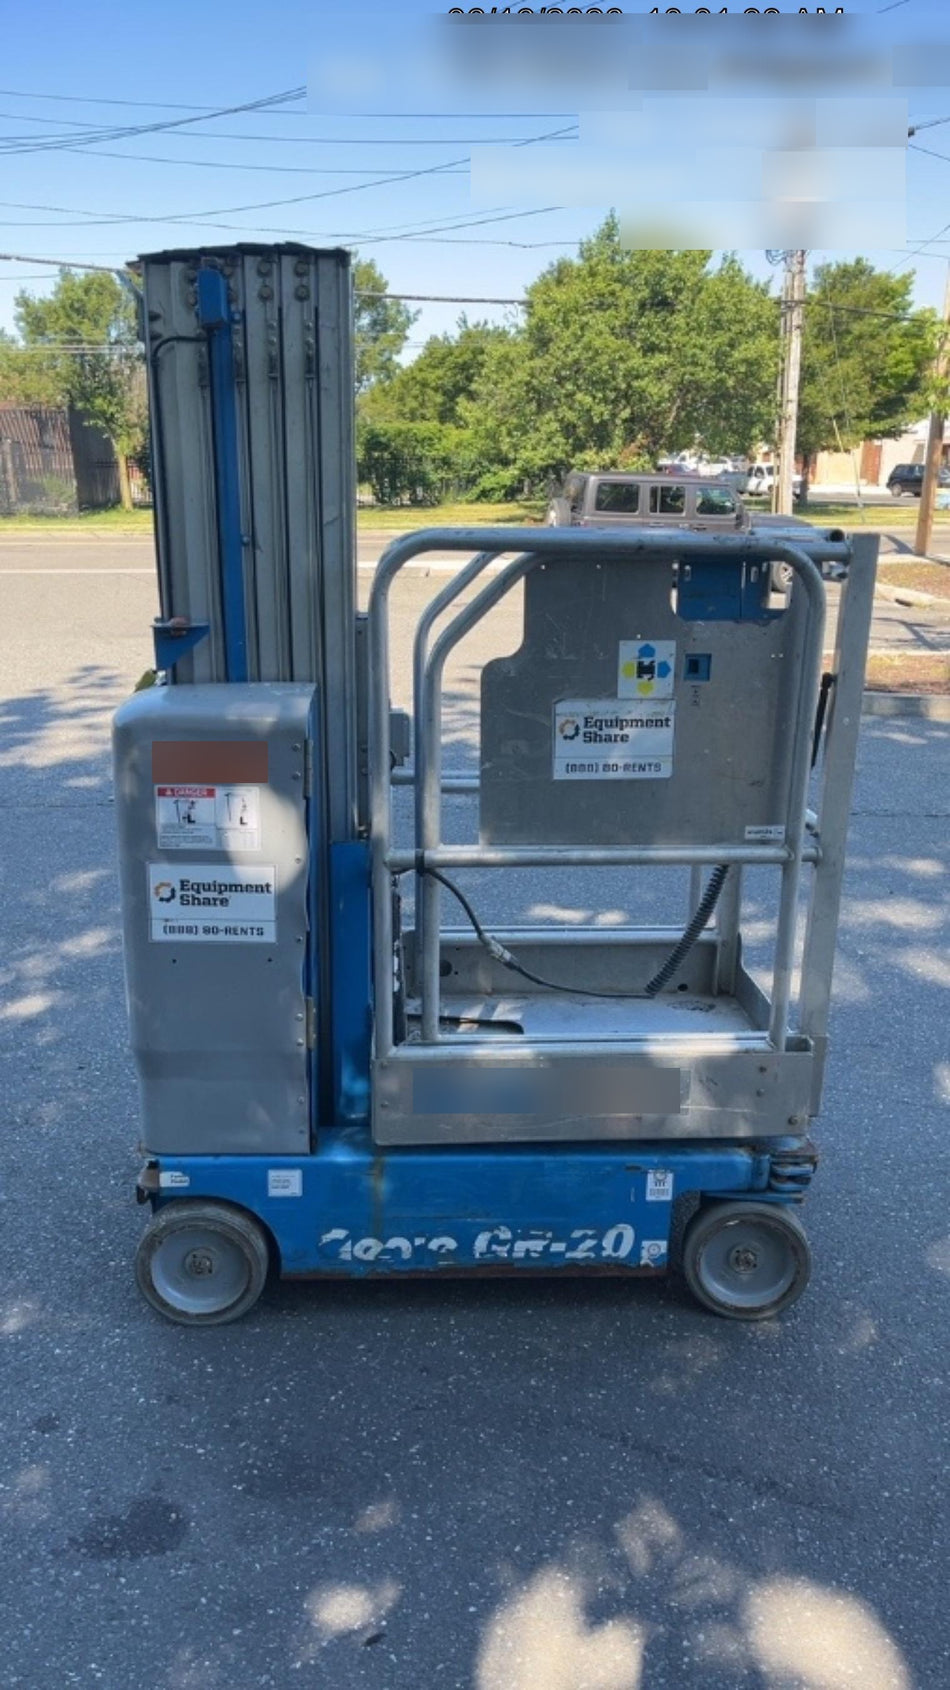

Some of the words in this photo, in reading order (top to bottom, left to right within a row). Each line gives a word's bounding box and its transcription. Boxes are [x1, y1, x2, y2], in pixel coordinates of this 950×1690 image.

[583, 716, 671, 731] Equipment
[583, 730, 630, 744] Share
[179, 879, 272, 895] Equipment
[179, 893, 230, 907] Share
[163, 925, 198, 936] (888)
[202, 925, 264, 936] 80-RENTS
